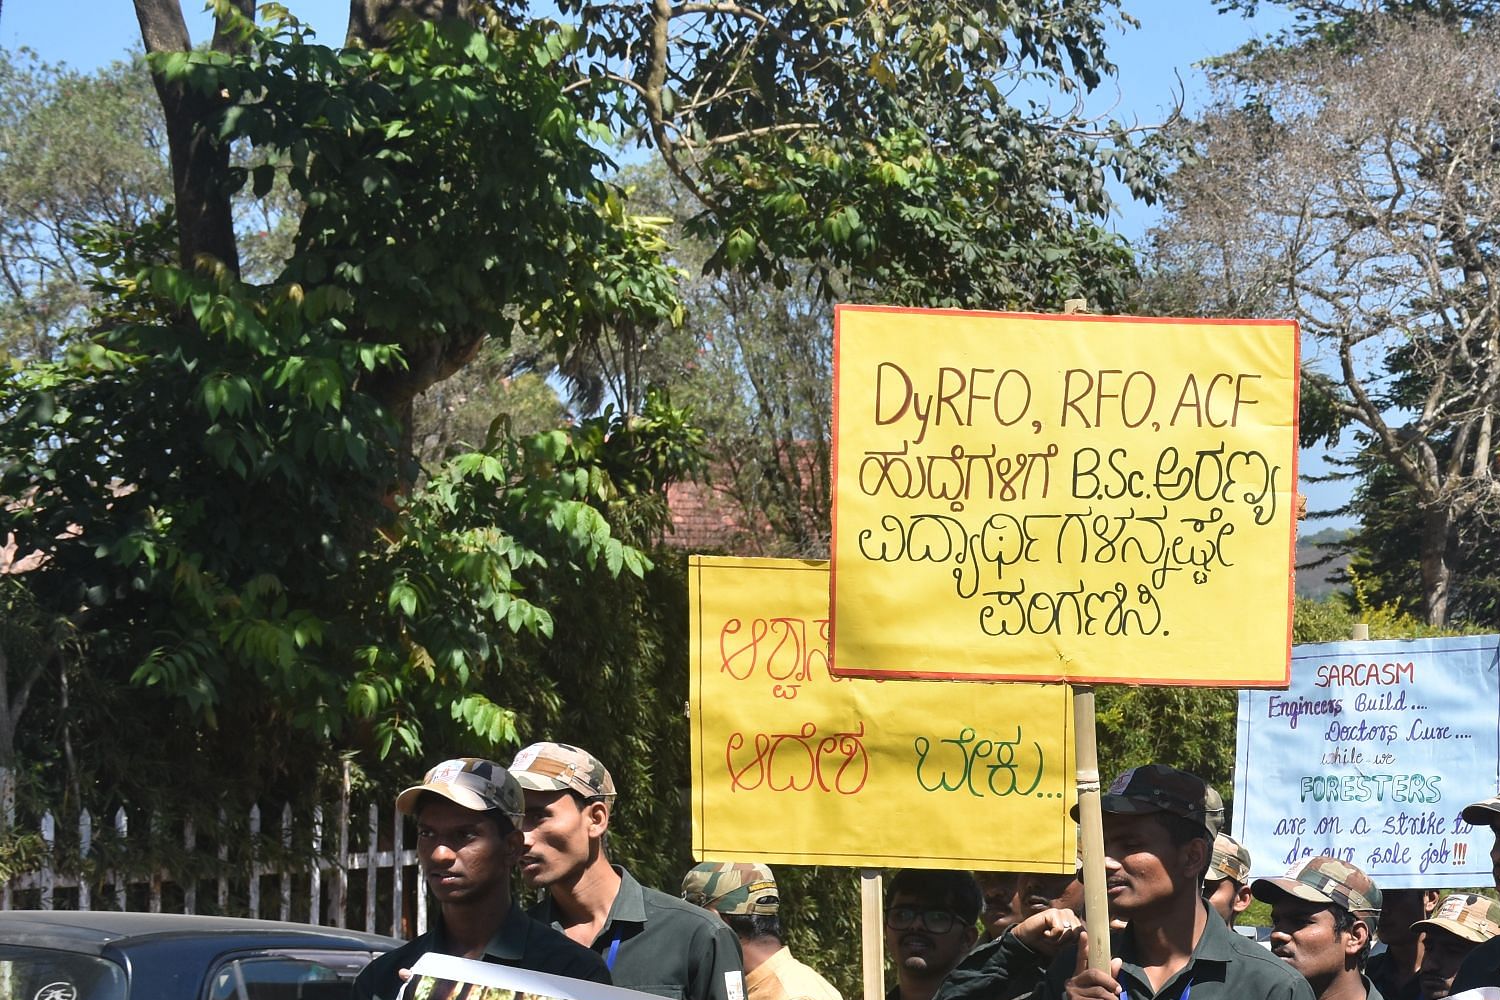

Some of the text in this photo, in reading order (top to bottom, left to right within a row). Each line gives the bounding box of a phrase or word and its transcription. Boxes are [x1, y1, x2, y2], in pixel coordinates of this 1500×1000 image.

[875, 362, 1261, 444] DyRFO, RFO, ACF
[858, 440, 1059, 511] ಹುದ್ದೆಗಳಿಗೆ
[1314, 662, 1414, 688] SARCASM
[1268, 696, 1343, 729] Engineers
[1324, 719, 1398, 745] Doctors
[726, 721, 871, 794] ಆದೇಶ
[1320, 747, 1396, 765] while we
[1300, 773, 1442, 803] FORESTERS
[1273, 816, 1306, 835] are
[1314, 817, 1343, 835] on
[1350, 817, 1371, 834] a
[1382, 812, 1445, 835] strike
[1367, 841, 1411, 868] sole
